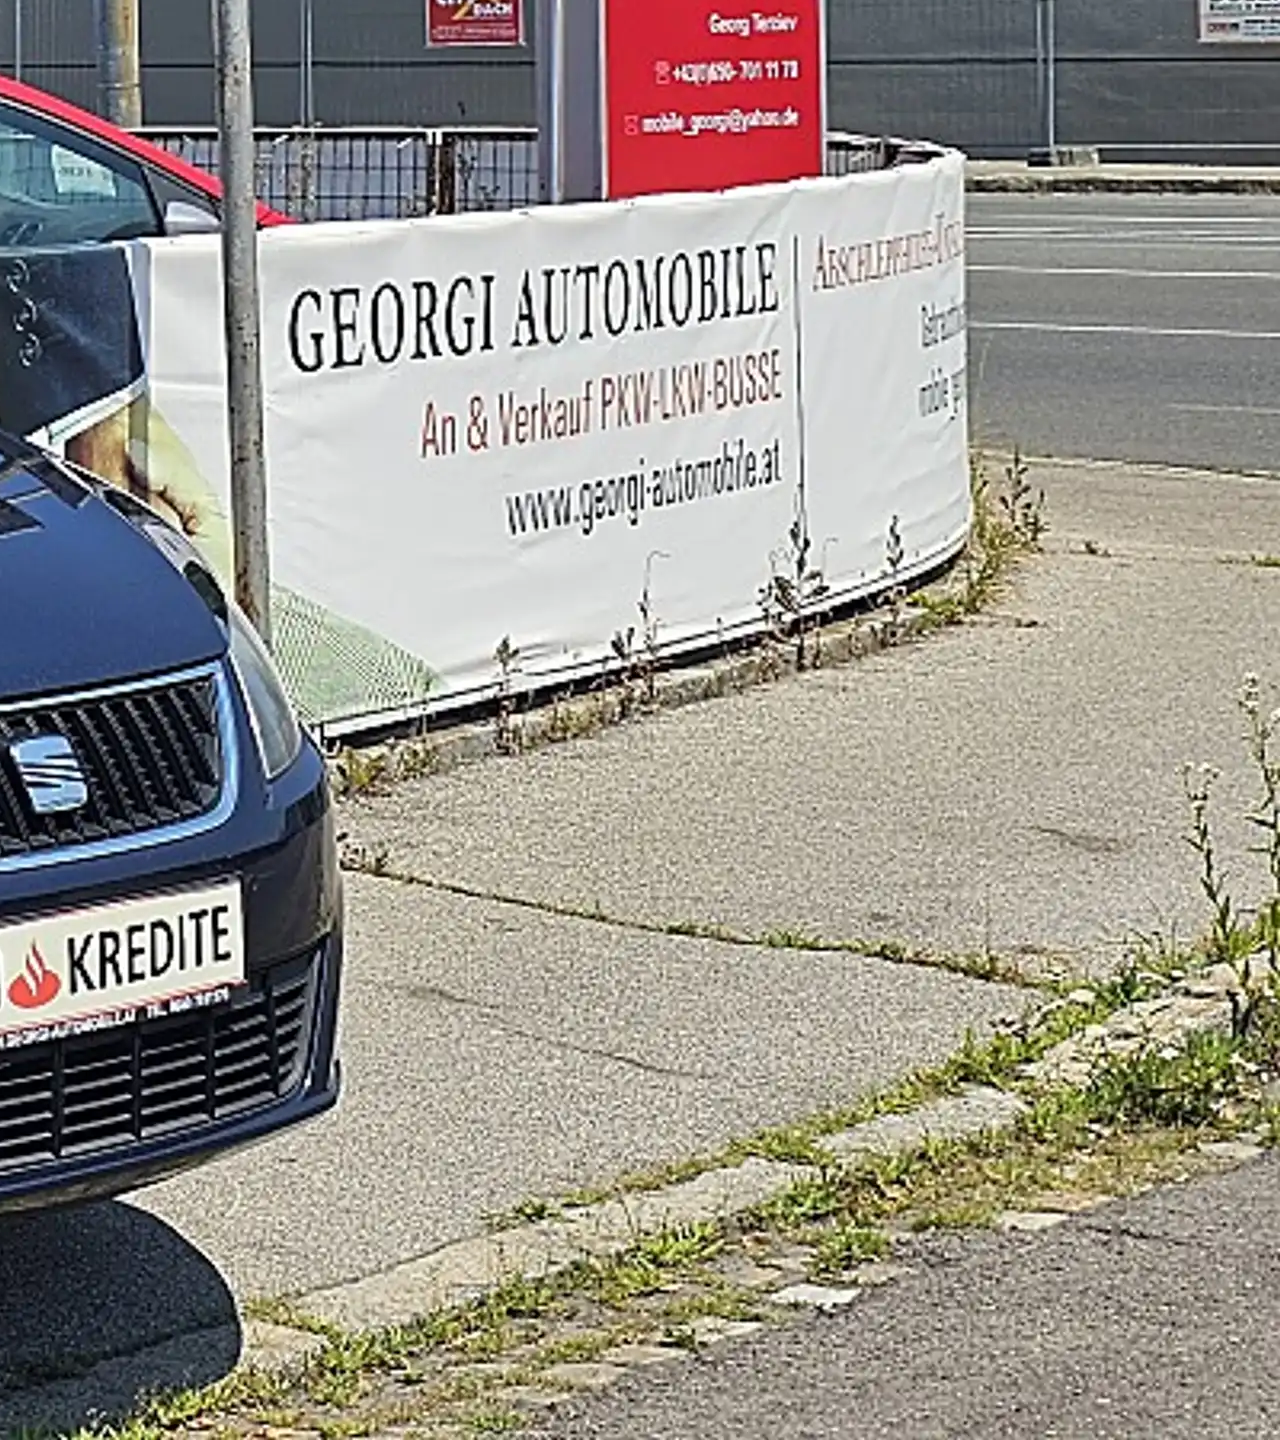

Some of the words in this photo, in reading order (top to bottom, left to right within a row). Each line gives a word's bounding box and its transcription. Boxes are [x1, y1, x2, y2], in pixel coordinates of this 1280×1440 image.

[288, 274, 496, 374] GEORGI
[511, 242, 781, 347] AUTOMOBILE
[421, 402, 457, 458] An
[466, 396, 488, 451] &
[498, 379, 594, 446] Verkauf
[600, 349, 783, 430] PKW-LKW-BUSSE
[505, 439, 783, 536] www.georgi-automobile.at
[67, 904, 232, 995] KREDITE
